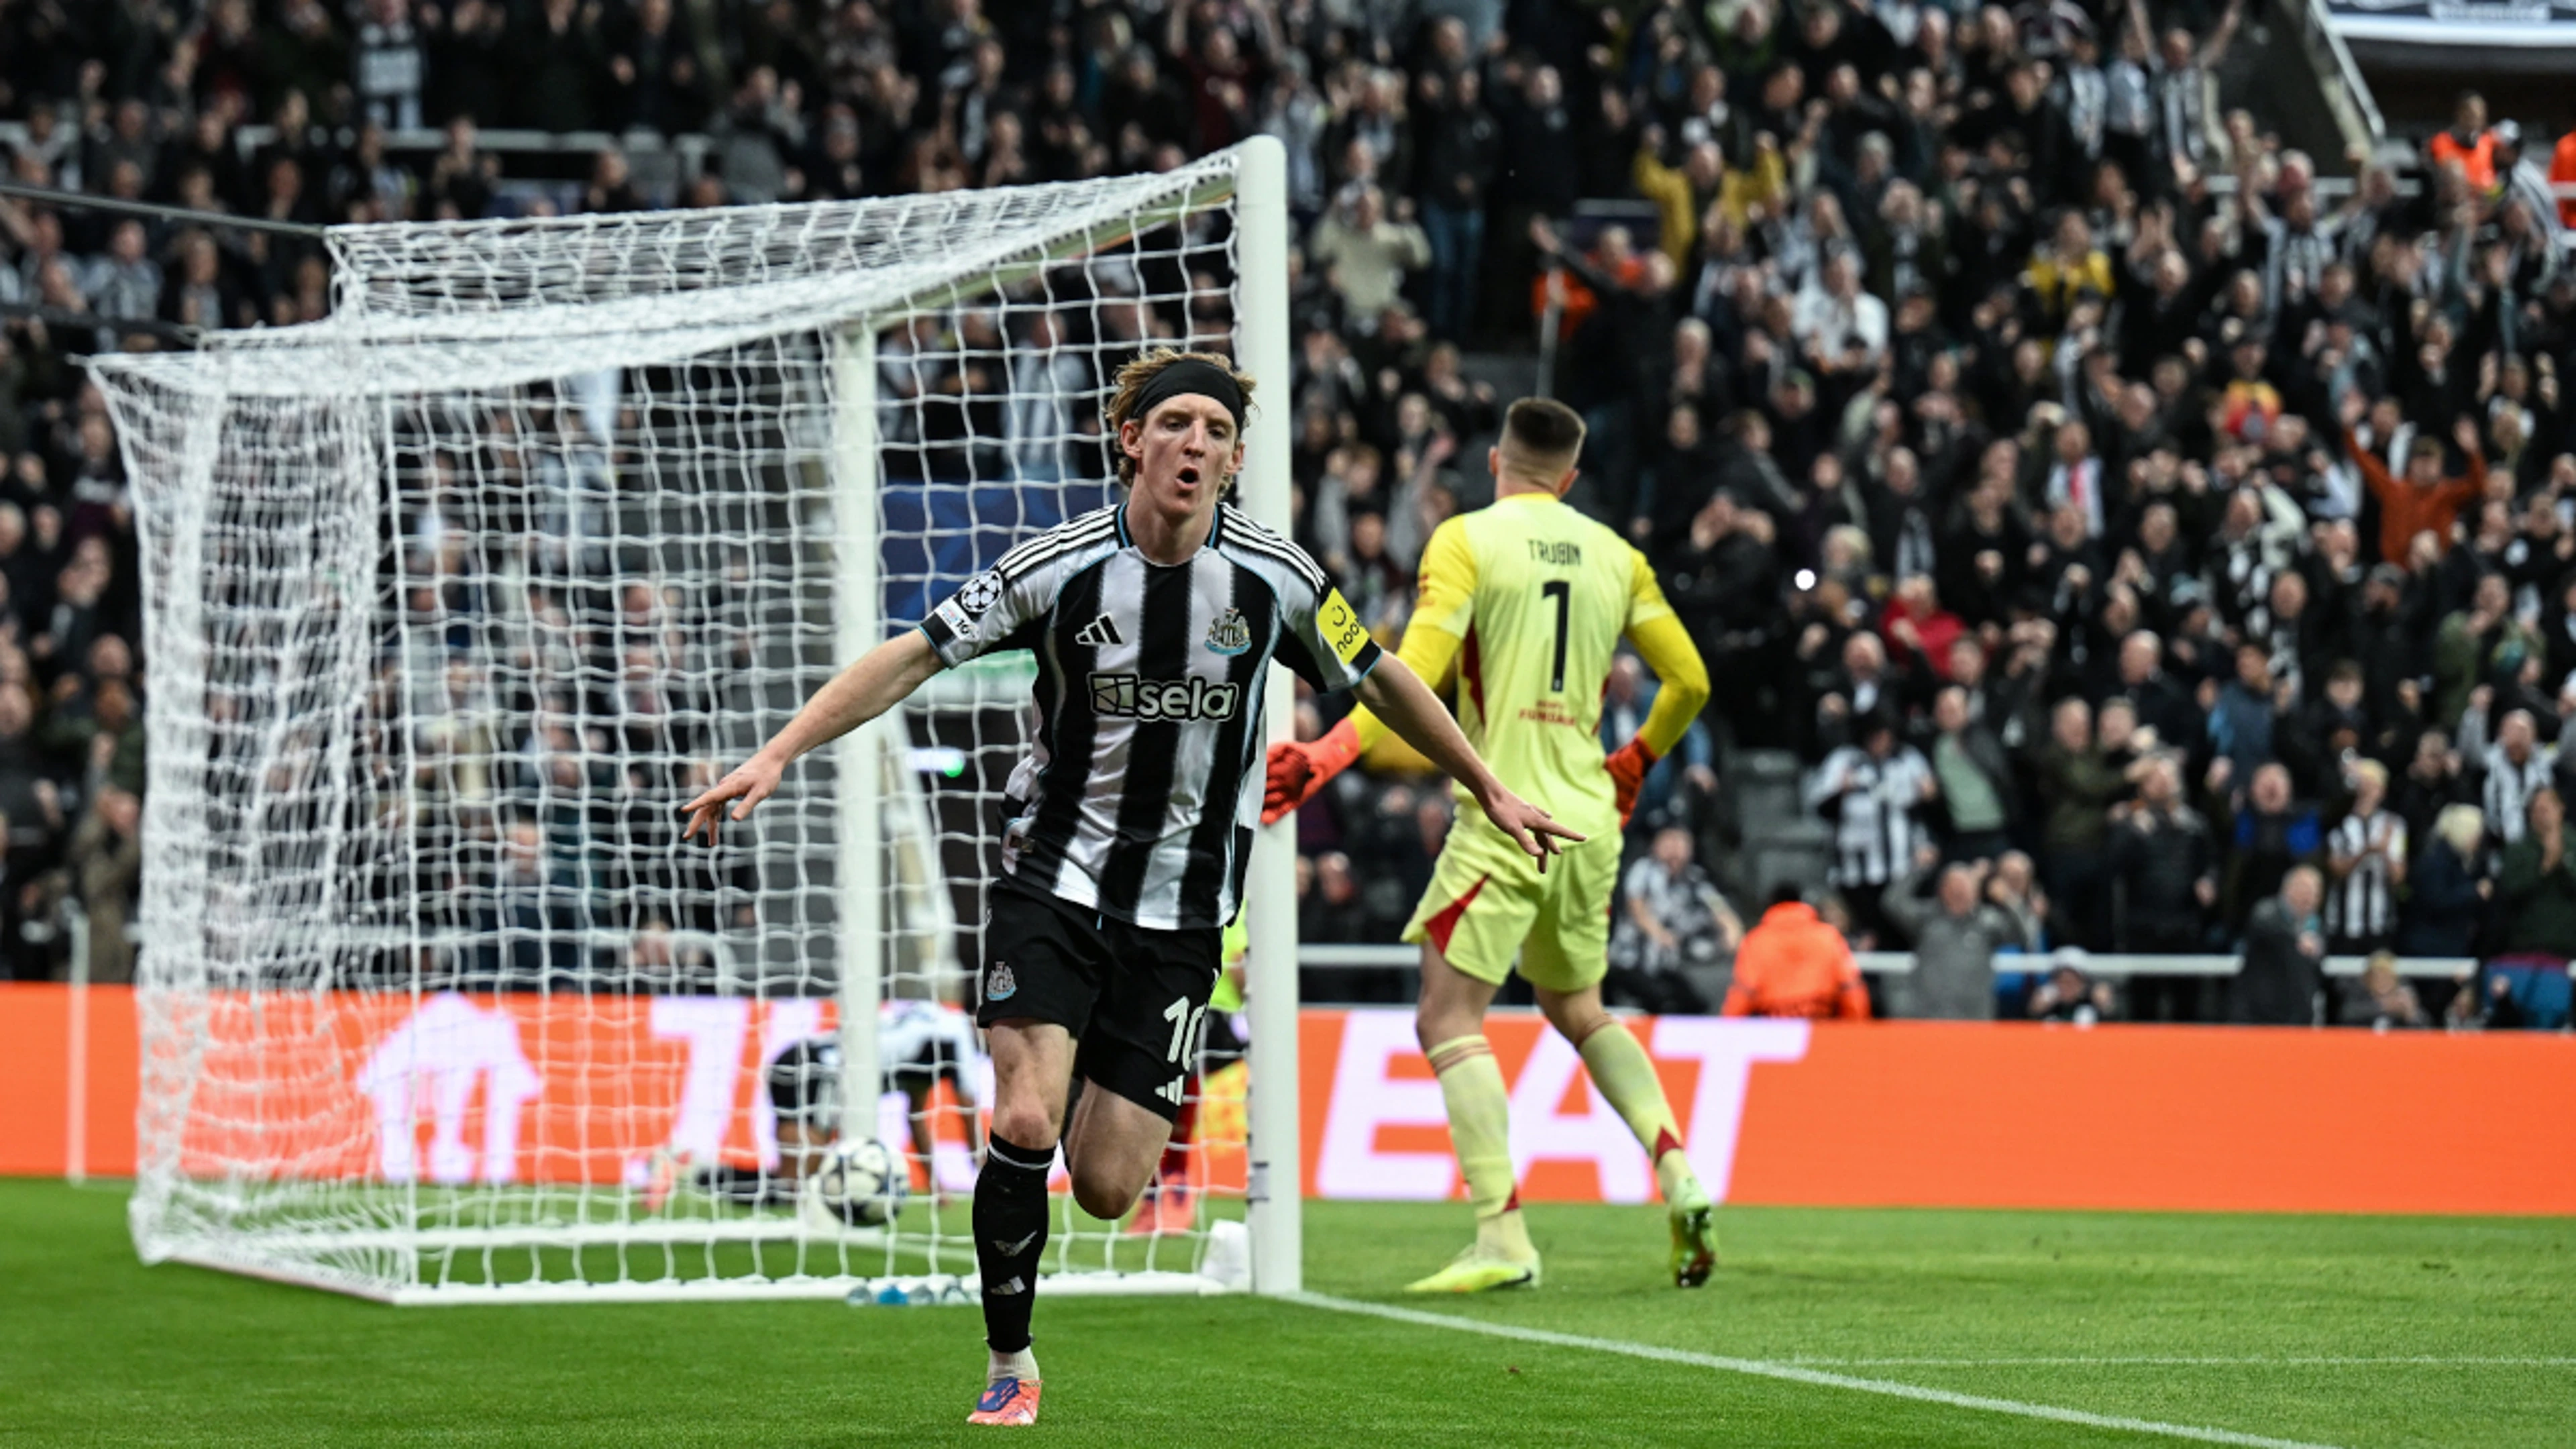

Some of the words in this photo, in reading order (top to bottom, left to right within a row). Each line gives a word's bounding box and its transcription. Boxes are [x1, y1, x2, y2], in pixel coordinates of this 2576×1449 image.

[1525, 538, 1581, 566] TRUBIN
[1542, 579, 1570, 693] 1
[1138, 678, 1235, 719] sela
[1315, 1009, 1811, 1203] EAT
